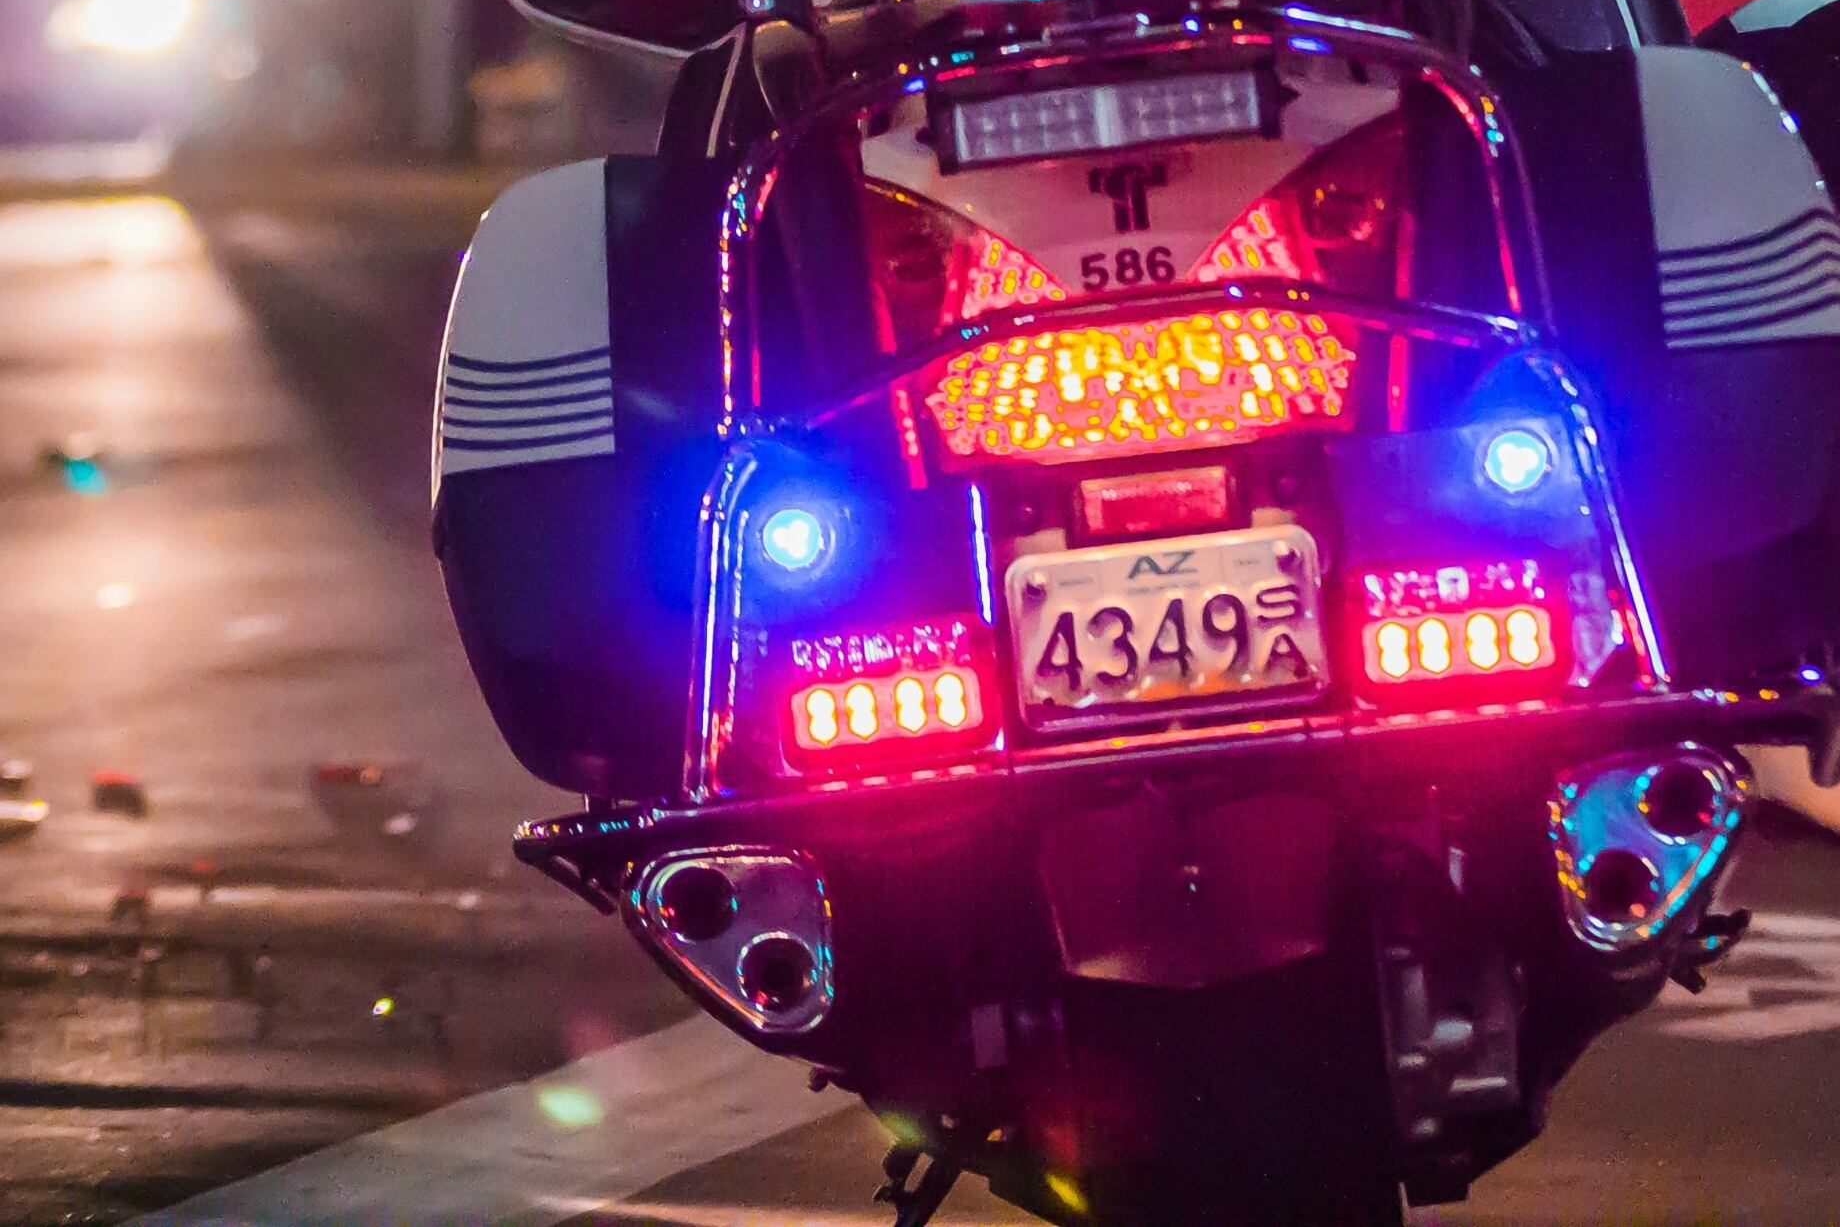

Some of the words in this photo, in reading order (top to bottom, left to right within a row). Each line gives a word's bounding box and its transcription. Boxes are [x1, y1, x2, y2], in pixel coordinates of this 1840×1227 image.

[1080, 246, 1175, 290] 586
[1128, 550, 1199, 579] AZ
[1036, 592, 1249, 692] 4349
